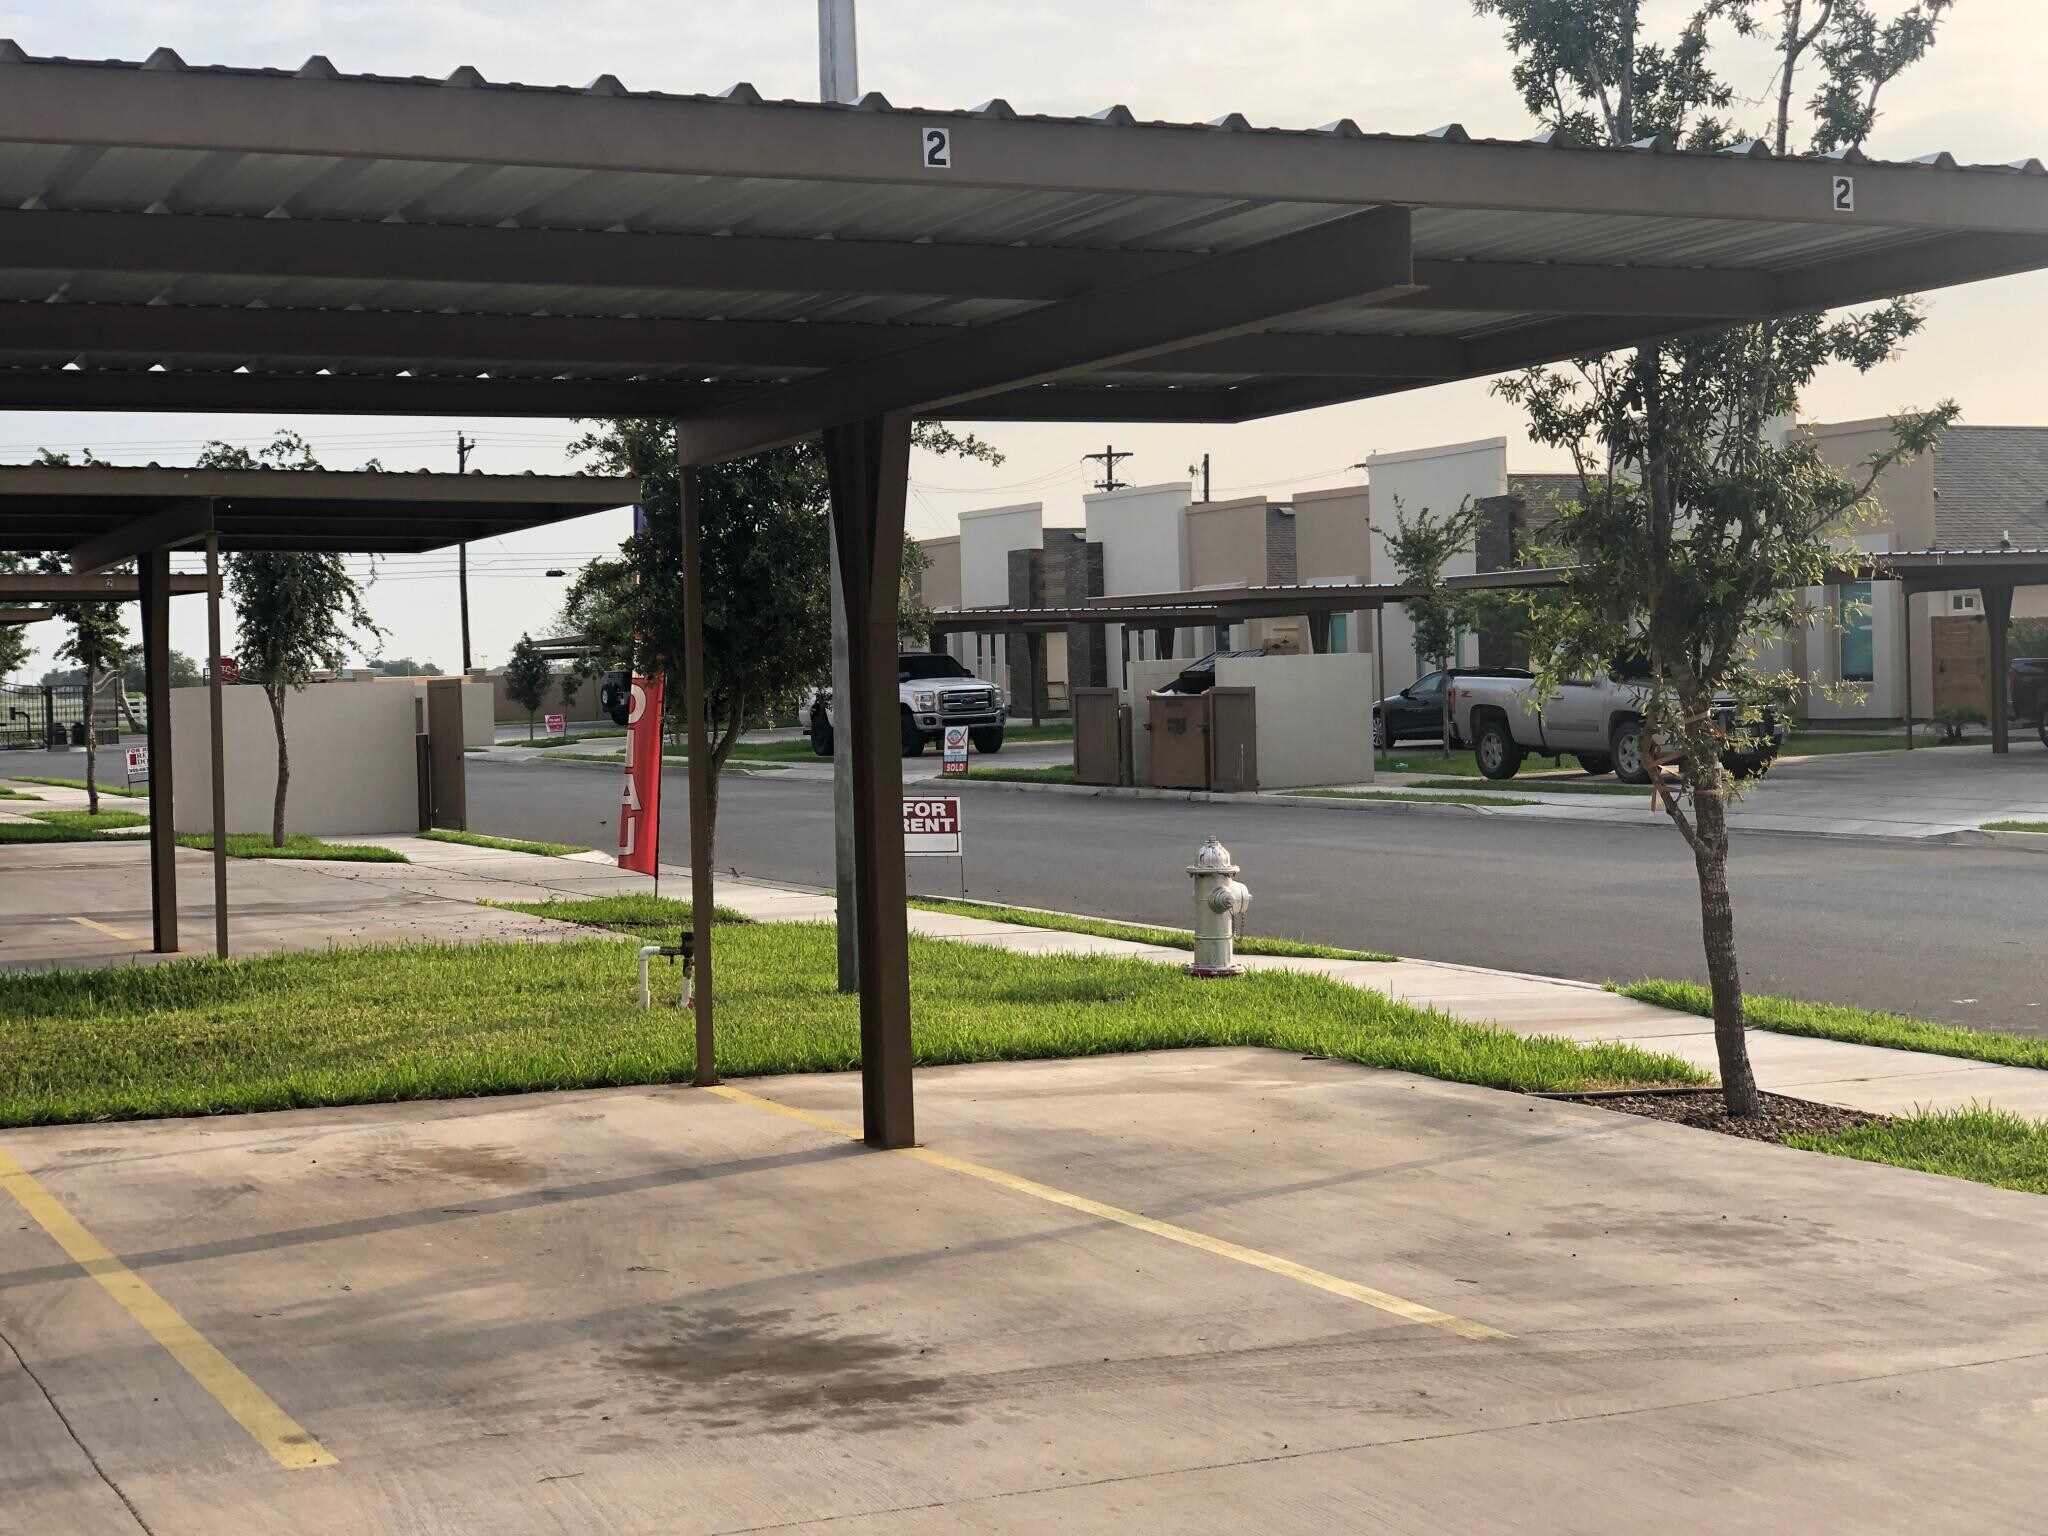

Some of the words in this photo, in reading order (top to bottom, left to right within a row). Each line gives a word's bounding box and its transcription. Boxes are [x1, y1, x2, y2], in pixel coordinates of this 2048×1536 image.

[927, 131, 946, 165] 2
[1836, 179, 1850, 208] 2
[946, 763, 964, 772] SOLD
[903, 802, 947, 817] FOR
